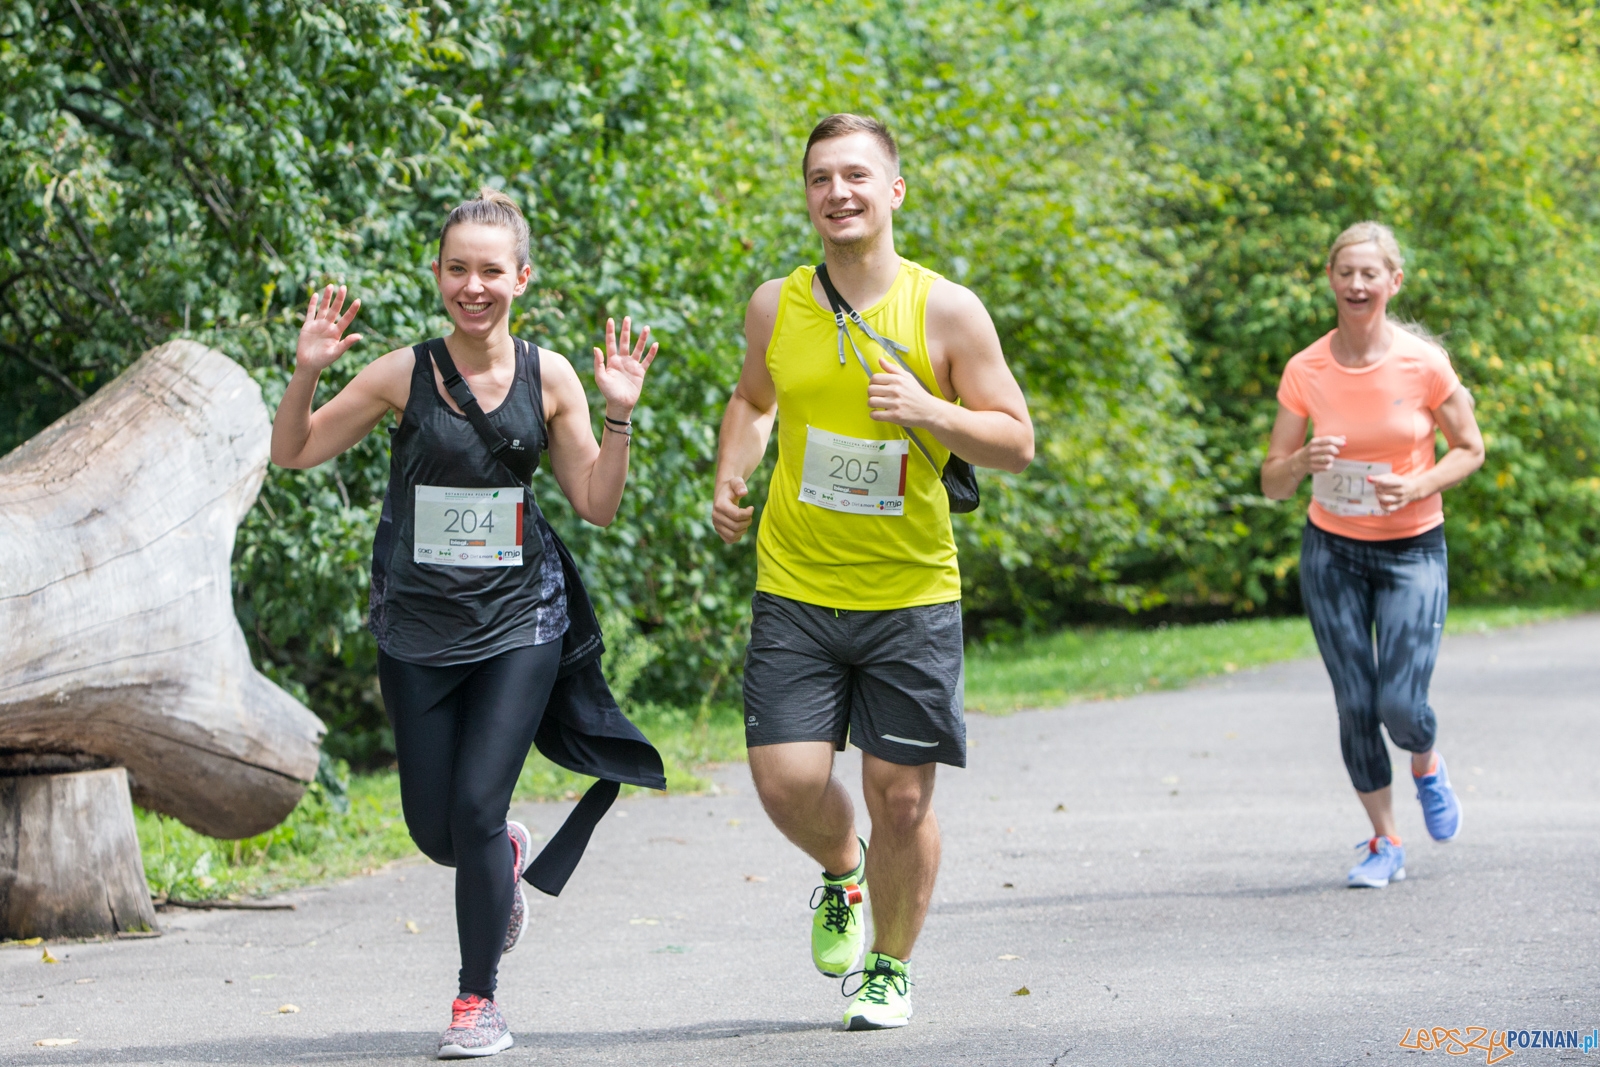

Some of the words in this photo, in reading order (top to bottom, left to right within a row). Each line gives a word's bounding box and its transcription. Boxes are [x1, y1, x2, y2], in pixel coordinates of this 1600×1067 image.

[829, 455, 879, 484] 205
[1333, 474, 1365, 495] 211
[886, 500, 902, 508] mjp
[444, 509, 494, 533] 204
[504, 550, 521, 558] mjp
